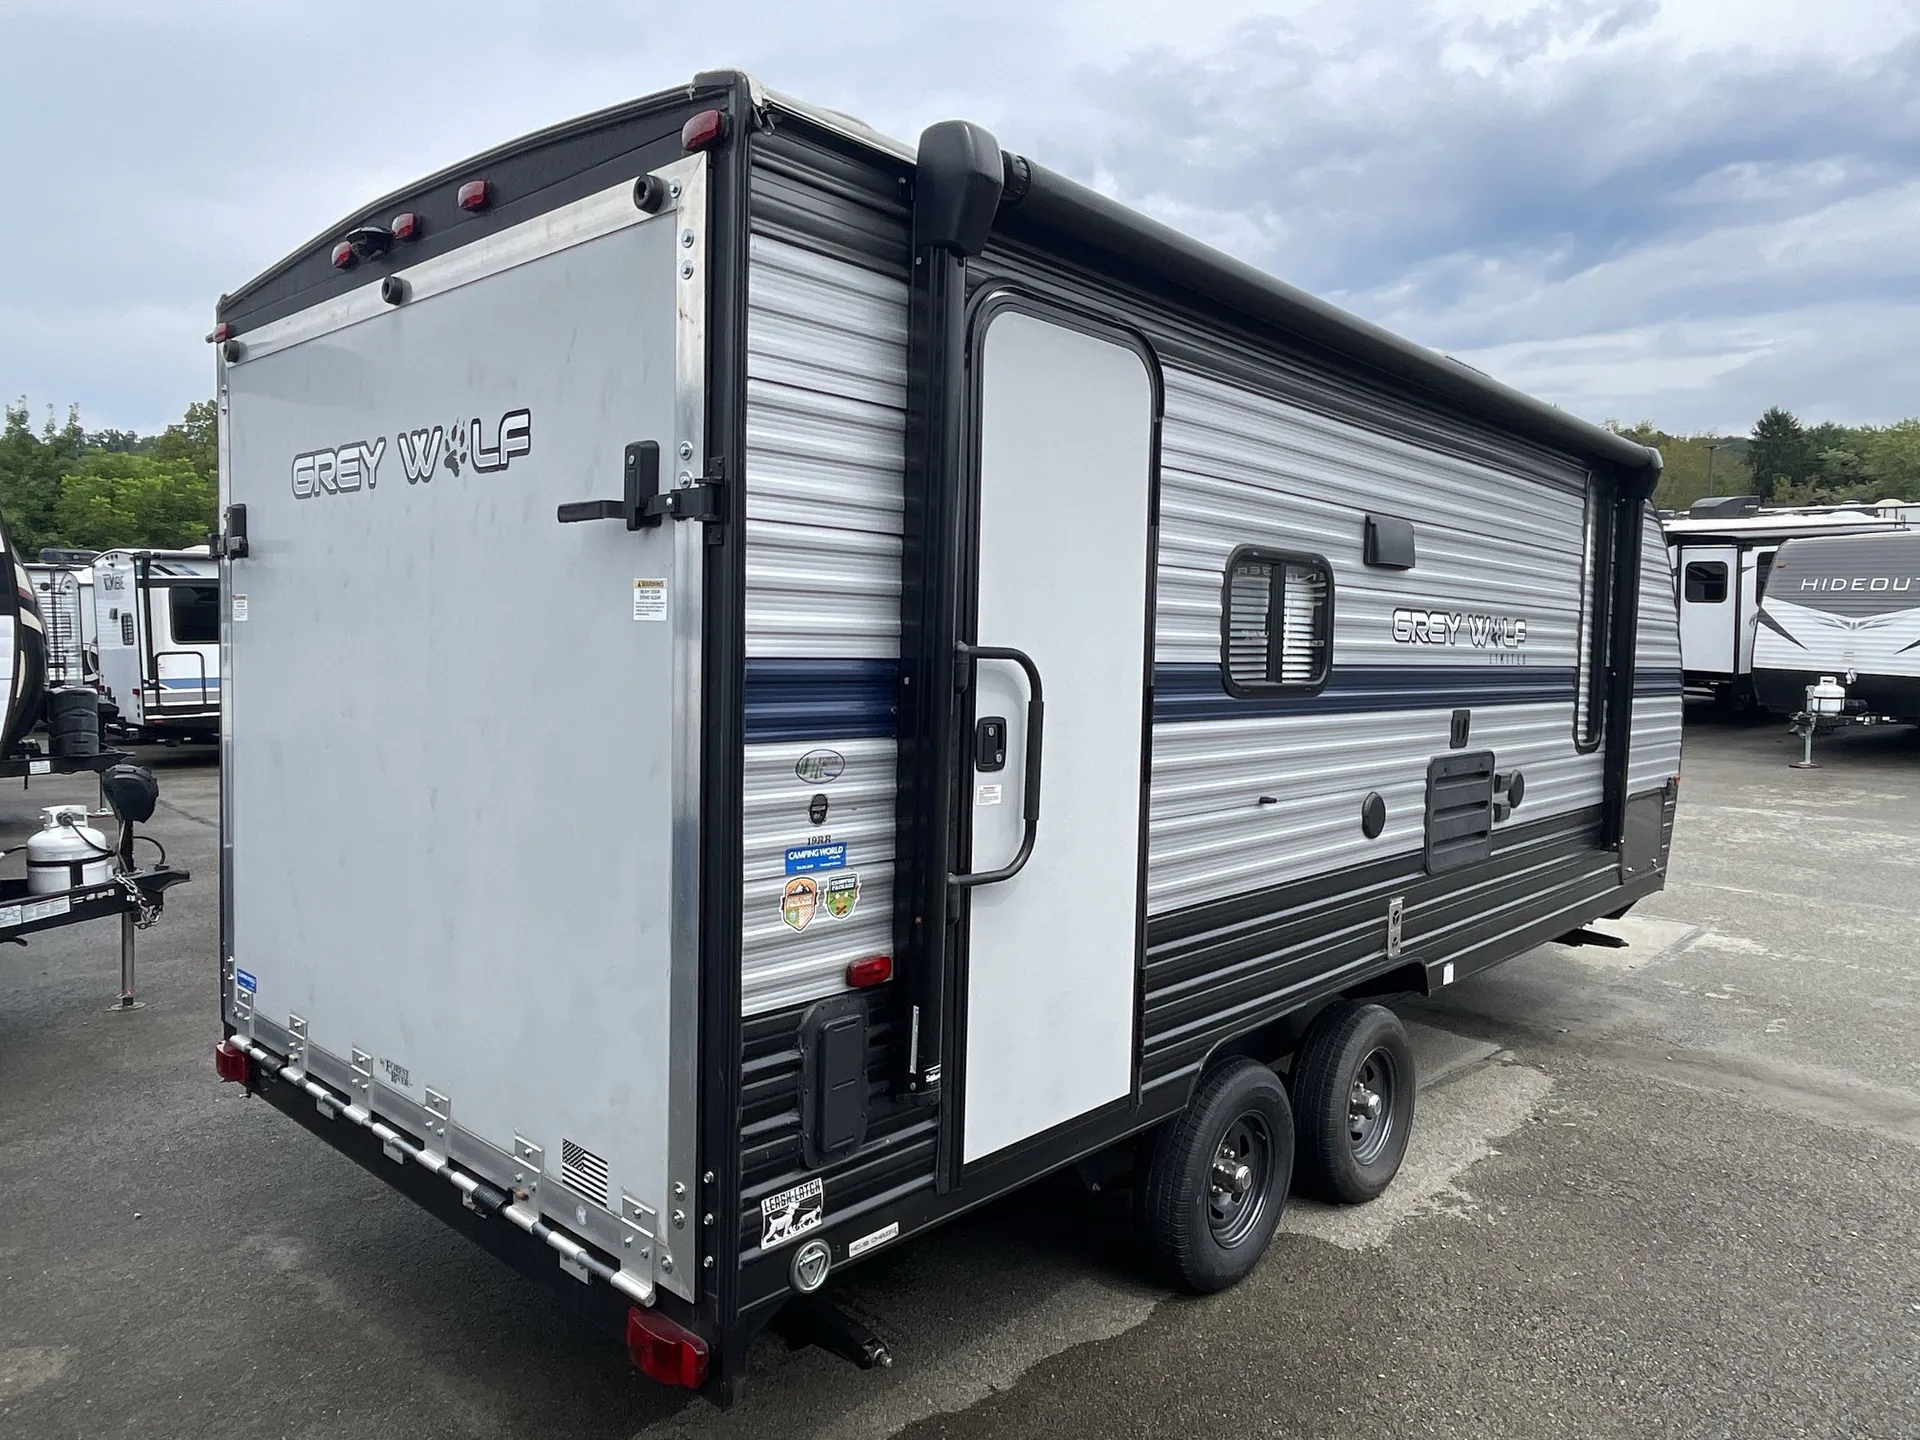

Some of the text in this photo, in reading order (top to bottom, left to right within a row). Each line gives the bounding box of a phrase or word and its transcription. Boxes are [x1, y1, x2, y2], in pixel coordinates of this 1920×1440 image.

[292, 436, 387, 499] GREY
[1800, 577, 1920, 592] HIDEOU
[1392, 607, 1462, 645] GREY
[788, 848, 819, 860] CAMPING
[819, 845, 844, 857] WORLD
